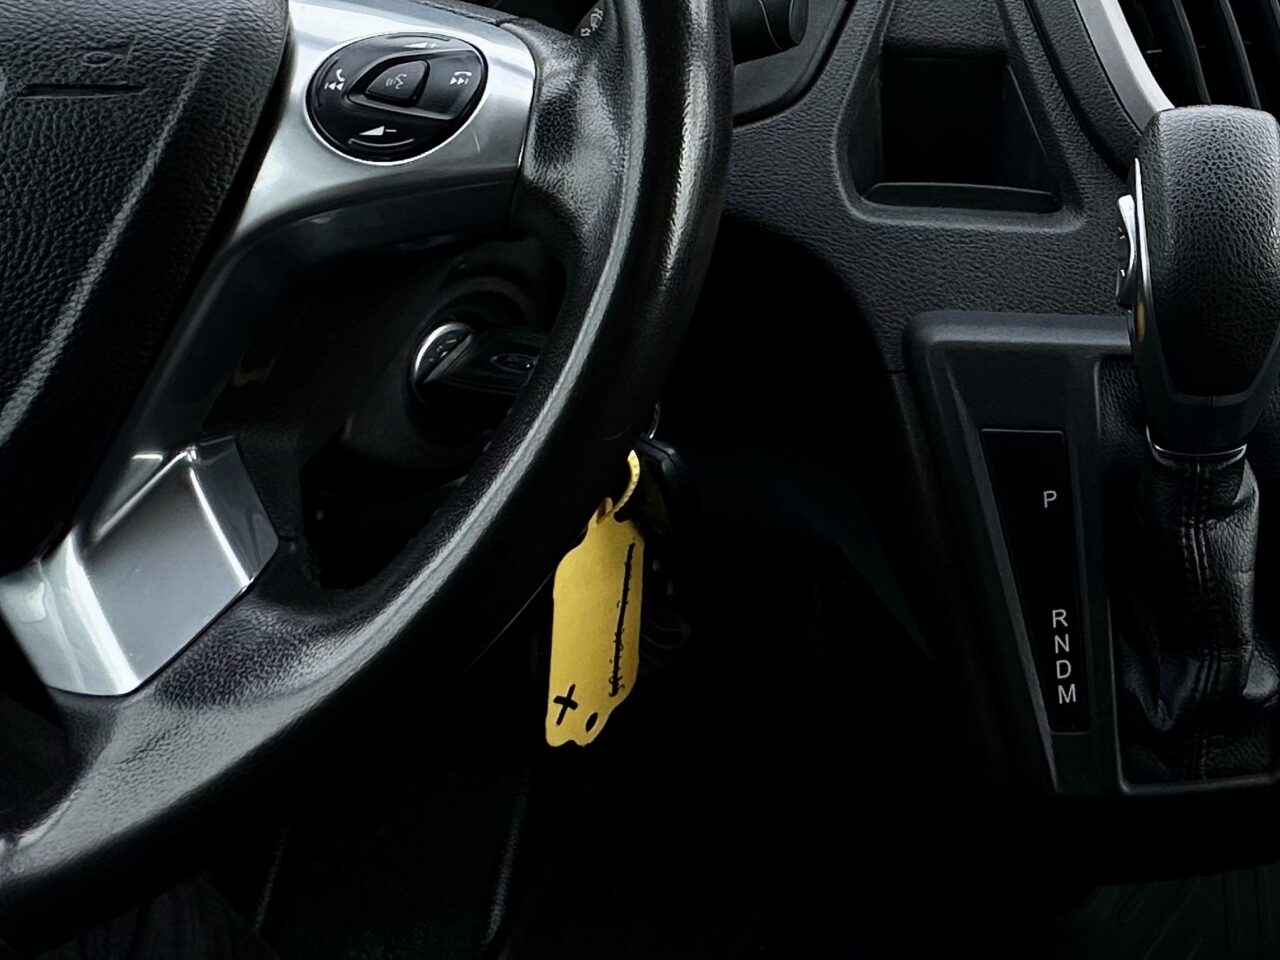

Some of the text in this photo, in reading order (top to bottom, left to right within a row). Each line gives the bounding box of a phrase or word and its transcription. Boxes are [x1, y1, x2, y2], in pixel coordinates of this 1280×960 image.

[1043, 491, 1057, 508] P
[1052, 609, 1068, 628] R
[1054, 634, 1070, 654] N
[1056, 659, 1072, 679] D
[1058, 683, 1077, 704] M
